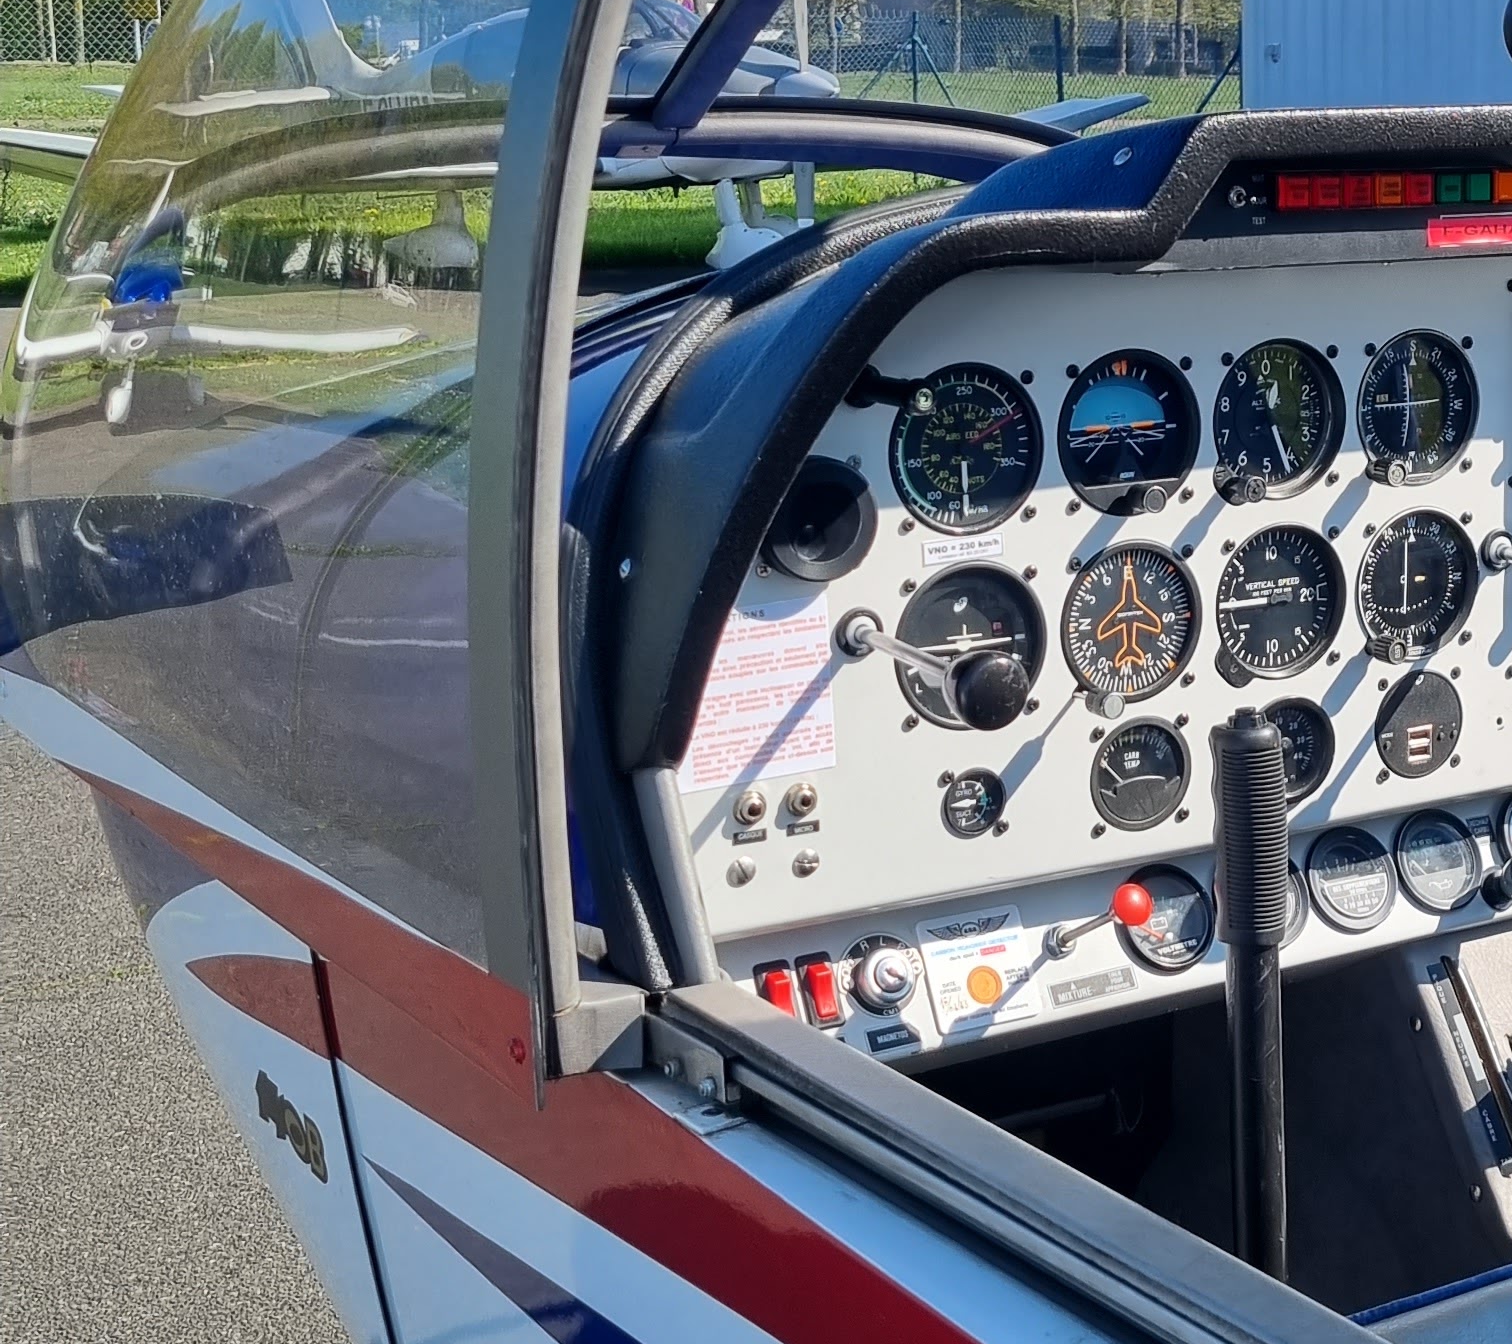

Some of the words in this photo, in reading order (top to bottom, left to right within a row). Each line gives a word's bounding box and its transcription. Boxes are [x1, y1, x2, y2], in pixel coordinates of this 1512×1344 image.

[1409, 340, 1416, 352] S
[1261, 360, 1271, 375] 0
[1289, 364, 1293, 381] 1
[1238, 371, 1247, 386] 9
[956, 387, 972, 396] 250
[1301, 384, 1310, 400] 2
[1220, 396, 1230, 412] 8
[1454, 398, 1463, 410] W
[990, 407, 1007, 416] 300
[1221, 429, 1230, 445] 7
[1301, 426, 1310, 442] 3
[907, 459, 922, 468] 150
[1000, 457, 1015, 466] 350
[1238, 450, 1248, 466] 6
[1262, 458, 1271, 473] 5
[927, 490, 942, 500] 100
[949, 501, 960, 510] 60
[1407, 516, 1417, 528] W
[1429, 522, 1440, 534] 30
[927, 546, 948, 555] VNO
[959, 542, 976, 551] 230
[978, 538, 1000, 548] km/h
[1265, 546, 1278, 561] 10
[1103, 573, 1112, 586] 6
[1143, 571, 1156, 585] 12
[1245, 581, 1276, 591] VERTICAL
[1278, 577, 1300, 588] SPEED
[1084, 594, 1096, 605] 3
[1158, 588, 1171, 602] 15
[1300, 588, 1314, 602] 20
[1162, 612, 1176, 622] S
[1078, 618, 1092, 630] N
[1157, 634, 1170, 649] 21
[1266, 639, 1278, 654] 10
[1082, 640, 1097, 657] 33
[1098, 657, 1114, 673] 30
[1120, 663, 1132, 676] W
[915, 683, 923, 694] L
[1289, 722, 1298, 730] 20
[1124, 752, 1140, 760] CARB
[1124, 760, 1140, 770] TEMP
[860, 940, 869, 952] R
[880, 937, 886, 946] L
[1058, 988, 1092, 1003] MIXTURE
